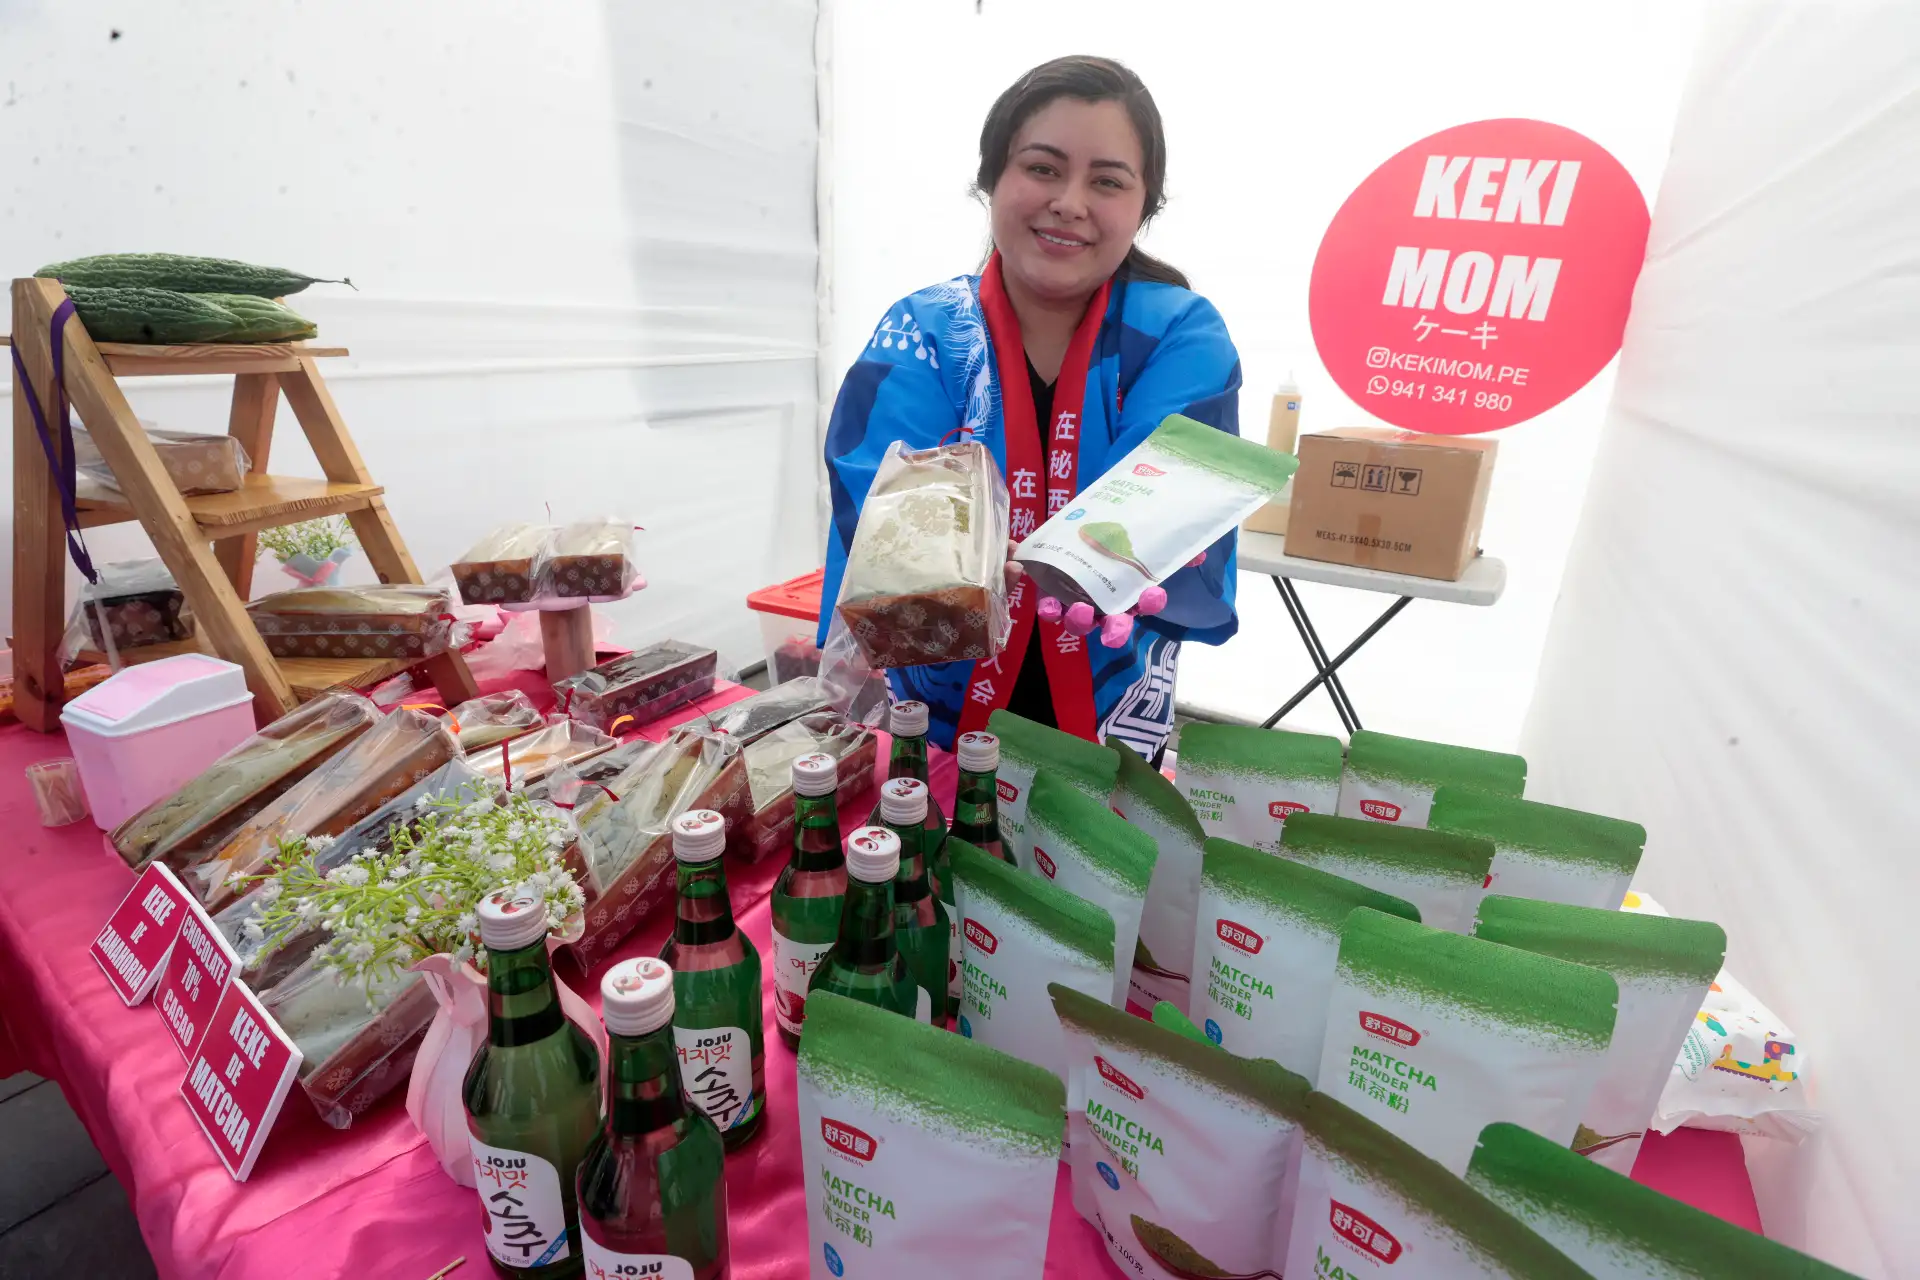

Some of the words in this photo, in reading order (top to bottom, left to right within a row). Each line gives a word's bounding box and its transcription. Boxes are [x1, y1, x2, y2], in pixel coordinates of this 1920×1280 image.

[1413, 155, 1582, 226] KEKI
[1382, 246, 1563, 322] MOM
[1413, 316, 1498, 350] ケーキ
[1390, 353, 1530, 385] KEKIMOM.PE
[1391, 383, 1425, 400] 941
[1432, 385, 1466, 405] 341
[1475, 391, 1512, 412] 980
[1188, 798, 1222, 809] POWDER
[1190, 788, 1236, 804] MATCHA
[1195, 809, 1223, 822] 茶粉
[998, 811, 1024, 834] ATCHA
[141, 884, 176, 927] KEKE
[130, 921, 148, 945] DE
[182, 915, 228, 988] CHOCOLATE
[96, 925, 148, 993] ZANAHORIA
[1211, 955, 1274, 1000] MATCHA
[181, 959, 202, 1003] 70%
[962, 974, 992, 1002] OWDER
[1209, 970, 1252, 1002] POWDER
[163, 989, 195, 1048] CACAO
[229, 1006, 271, 1070] KEKE
[696, 1032, 732, 1048] JOJU
[225, 1053, 245, 1087] DE
[1350, 1058, 1409, 1093] POWDER
[1352, 1045, 1437, 1092] MATCHA
[189, 1056, 251, 1156] MATCHA
[692, 1066, 742, 1122] 소주
[1348, 1070, 1409, 1114] 抹茶粉
[1086, 1099, 1165, 1157] MATCHA
[1086, 1119, 1139, 1158] POWDER
[486, 1156, 527, 1169] JOJU
[821, 1163, 896, 1221] MATCHA
[490, 1191, 548, 1258] 소주
[615, 1262, 662, 1276] JOJU
